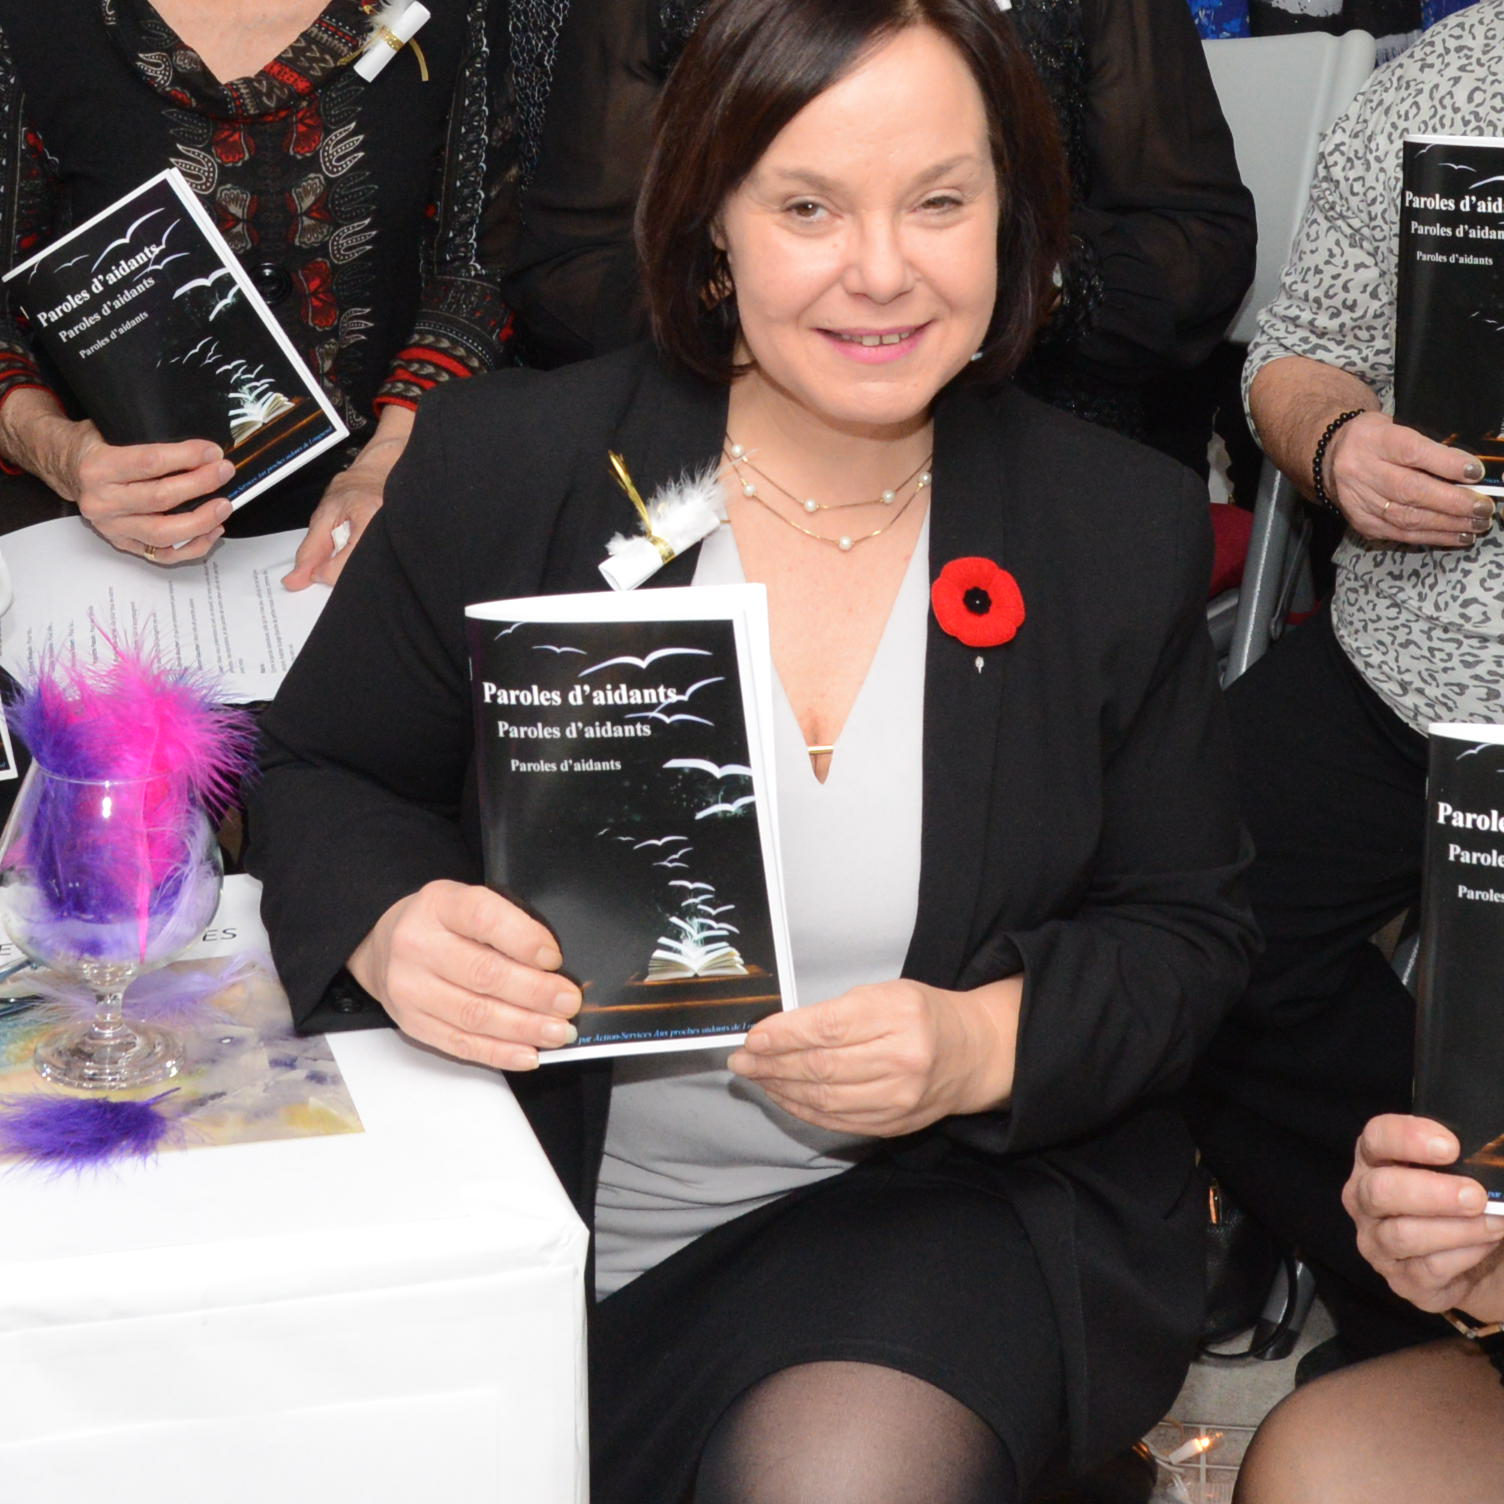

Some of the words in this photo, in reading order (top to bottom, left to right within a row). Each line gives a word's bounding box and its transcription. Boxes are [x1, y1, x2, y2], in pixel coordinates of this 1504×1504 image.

[1405, 190, 1456, 212] Paroles
[1411, 221, 1453, 238] Paroles
[1416, 250, 1447, 264] Paroles
[1449, 253, 1494, 266] d'aidants
[37, 287, 90, 328] Paroles
[91, 241, 161, 295] d'aidants
[58, 310, 101, 343] Paroles
[101, 276, 157, 316] d'aidants
[79, 335, 110, 361] Paroles
[109, 310, 149, 340] d'aidants
[482, 681, 562, 706] Paroles
[568, 683, 678, 706] d'aidants
[497, 721, 561, 740] Paroles
[565, 720, 652, 739] d'aidants
[510, 759, 558, 773] Paroles
[560, 758, 622, 772] d'aidants
